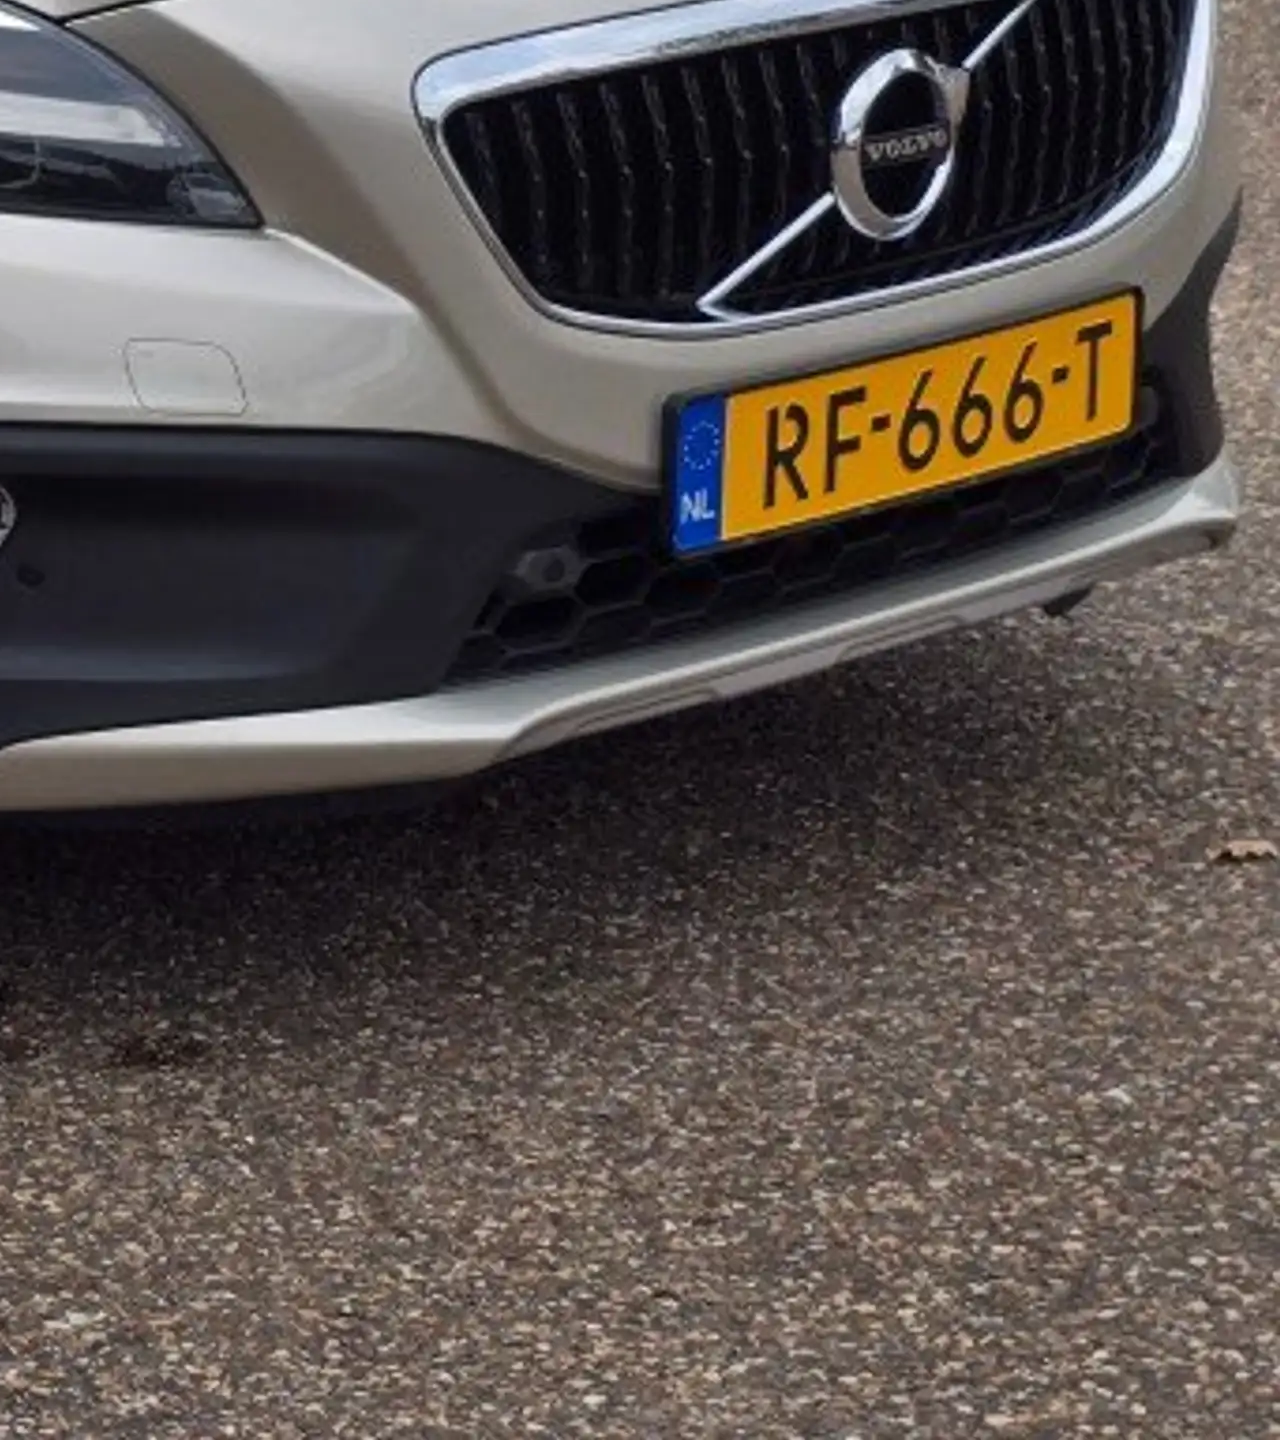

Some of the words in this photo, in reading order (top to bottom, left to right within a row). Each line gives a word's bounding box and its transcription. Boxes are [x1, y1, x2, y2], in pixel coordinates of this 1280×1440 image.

[864, 127, 948, 161] VOLVO
[762, 319, 1114, 511] RF-666-T
[680, 488, 717, 524] NL
